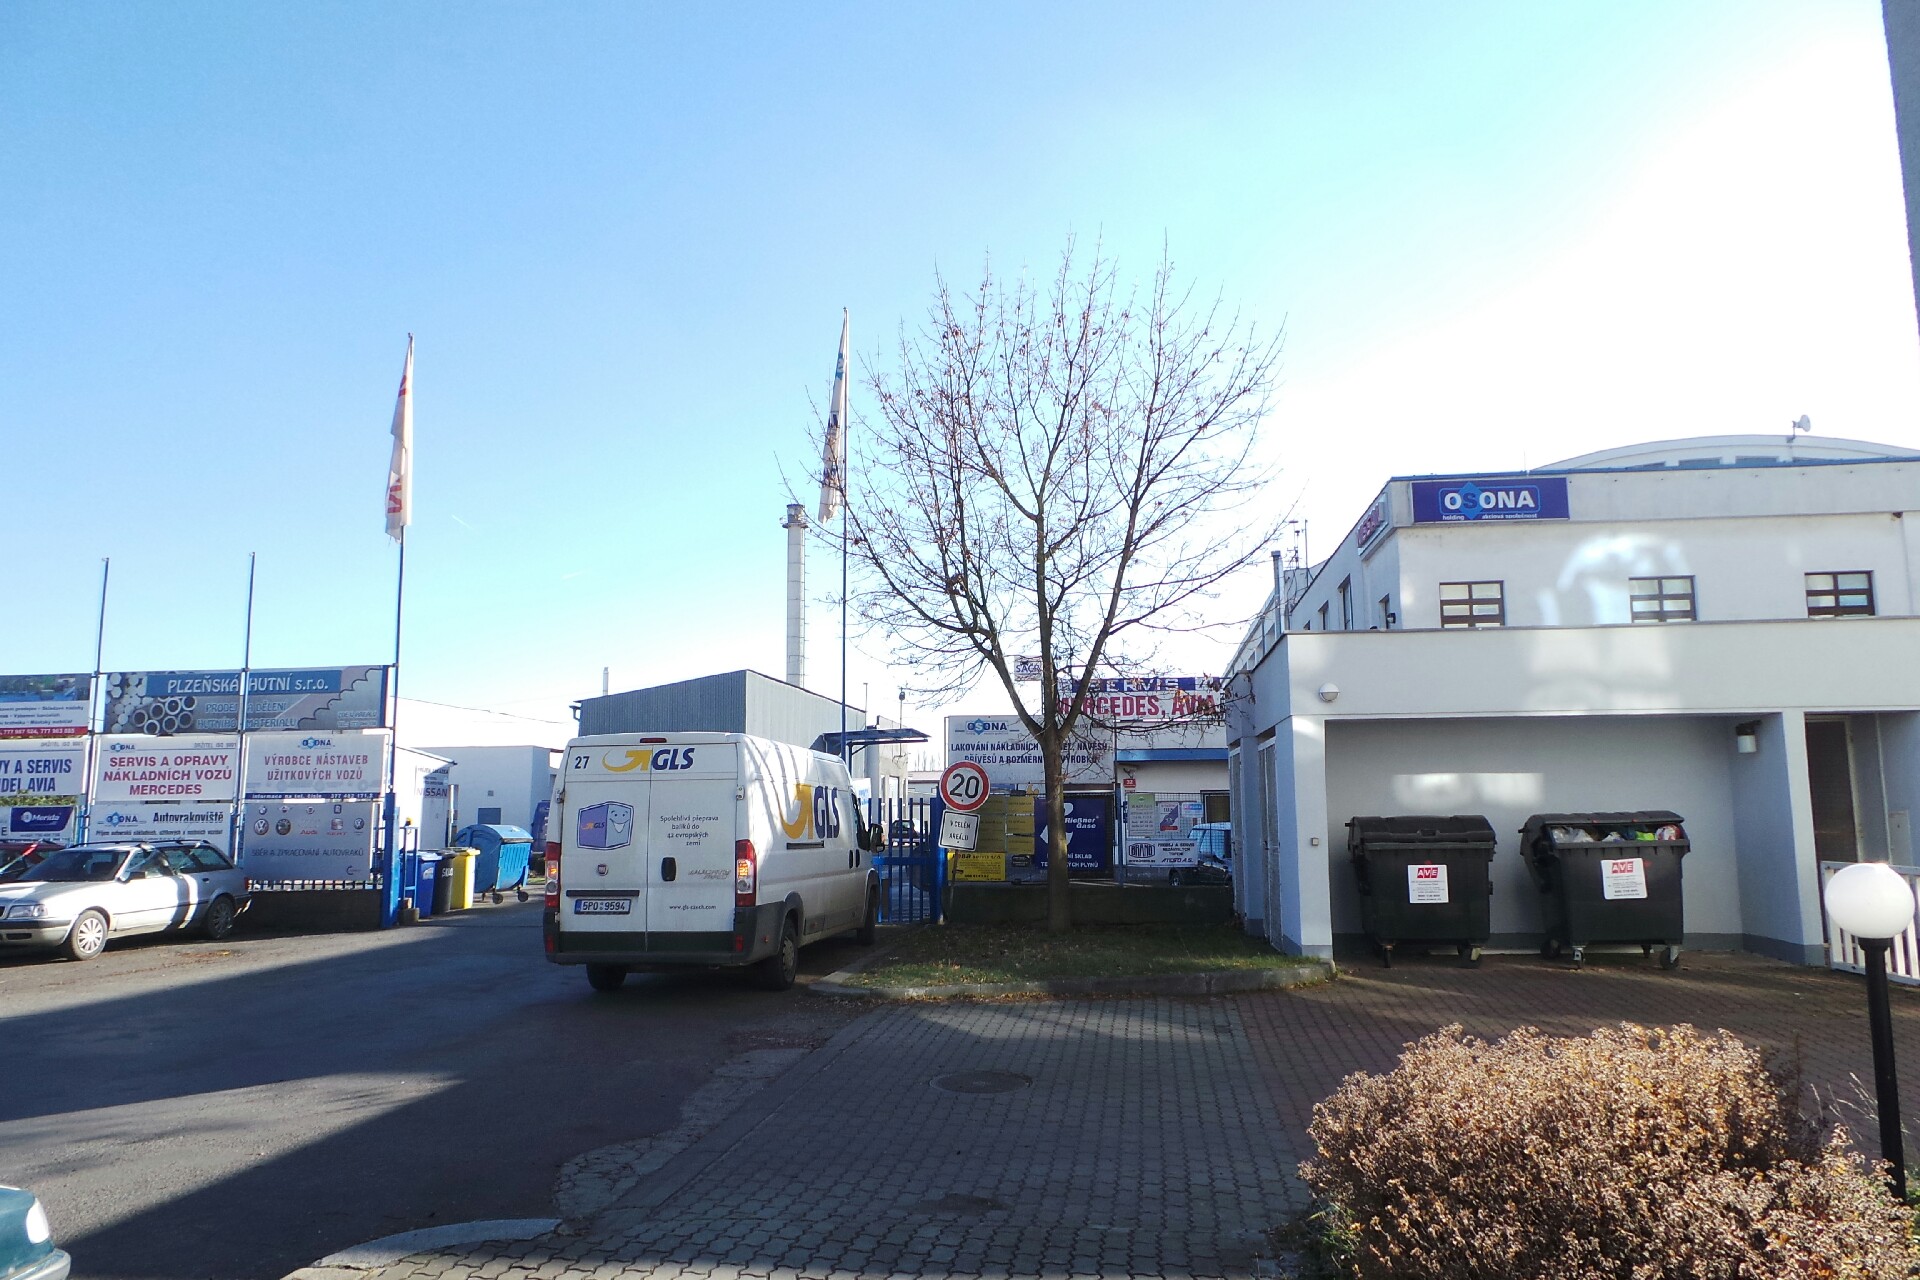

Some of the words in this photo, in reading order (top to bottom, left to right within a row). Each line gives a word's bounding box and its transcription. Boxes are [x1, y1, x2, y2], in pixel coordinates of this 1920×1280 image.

[1444, 490, 1535, 510] OSONA
[168, 675, 239, 693] PLZEŇSKÁ
[248, 673, 293, 691] HUTNÍ
[294, 679, 329, 690] s.r.o.
[967, 721, 1008, 731] OSONA
[302, 739, 331, 747] OSONA
[951, 741, 989, 751] LAKOVÁNÍ
[990, 741, 1039, 751] NÁKLADNÍCH
[110, 756, 156, 768] SERVIS
[160, 756, 169, 767] A
[174, 755, 228, 766] OPRAVY
[264, 754, 311, 766] VÝROBCE
[316, 752, 368, 765] NÁSTAVEB
[574, 756, 590, 770] 27
[652, 748, 695, 770] GLS
[14, 760, 23, 774] A
[27, 759, 72, 773] SERVIS
[103, 768, 190, 781] NÁKLADNÍCH
[195, 765, 232, 780] VOZŮ
[267, 768, 331, 781] UŽITKOVÝCH
[336, 766, 363, 780] VOZŮ
[28, 777, 56, 792] AVIA
[129, 784, 202, 796] MERCEDES
[950, 773, 980, 799] 20
[106, 814, 138, 823] OSONA
[153, 811, 224, 823] Autovrakoviště
[660, 814, 691, 823] Spolehlivá
[692, 814, 719, 823] přeprava
[813, 785, 840, 839] GLS
[675, 831, 709, 839] evropských
[583, 901, 599, 911] 5P0
[604, 901, 625, 910] 9594
